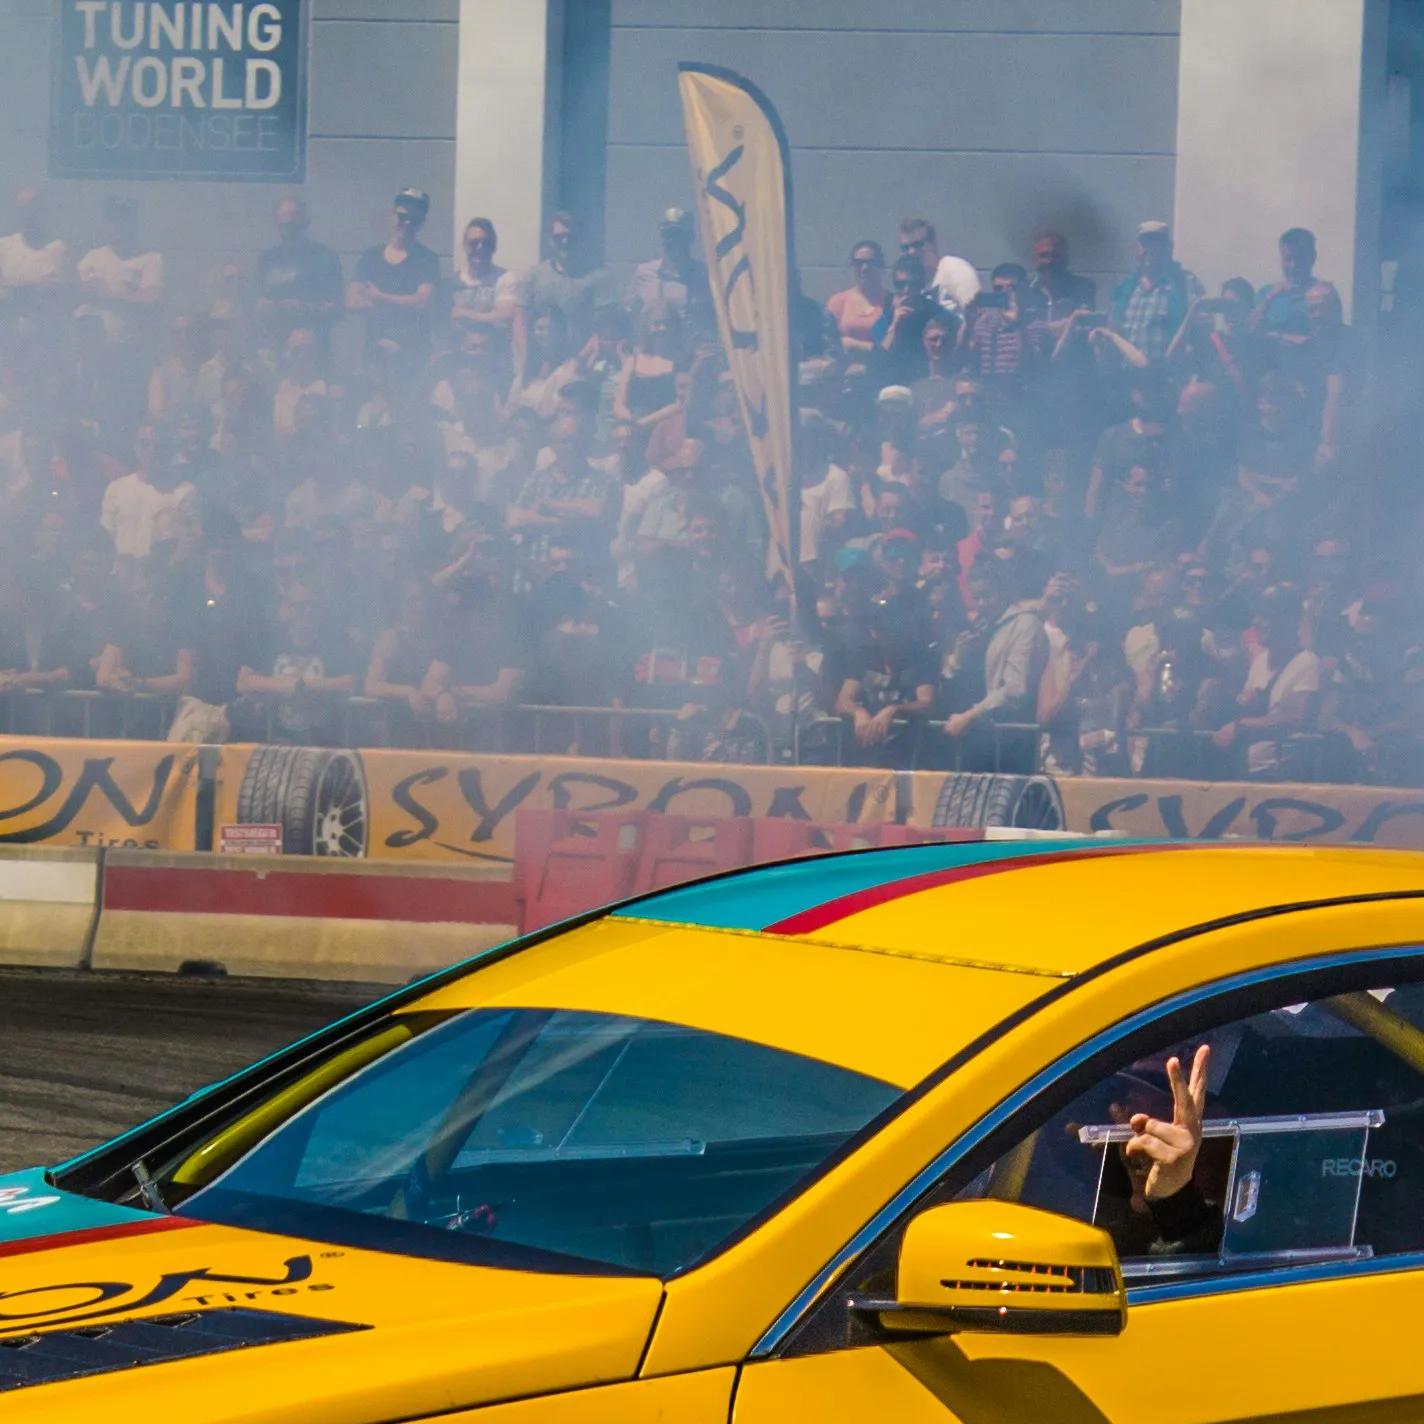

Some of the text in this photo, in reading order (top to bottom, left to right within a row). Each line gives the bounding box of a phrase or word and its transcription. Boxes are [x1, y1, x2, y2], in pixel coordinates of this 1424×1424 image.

[76, 2, 283, 52] TUNING
[74, 54, 283, 110] WORLD
[74, 111, 280, 152] BODENSEE
[1321, 1158, 1397, 1178] RECARO
